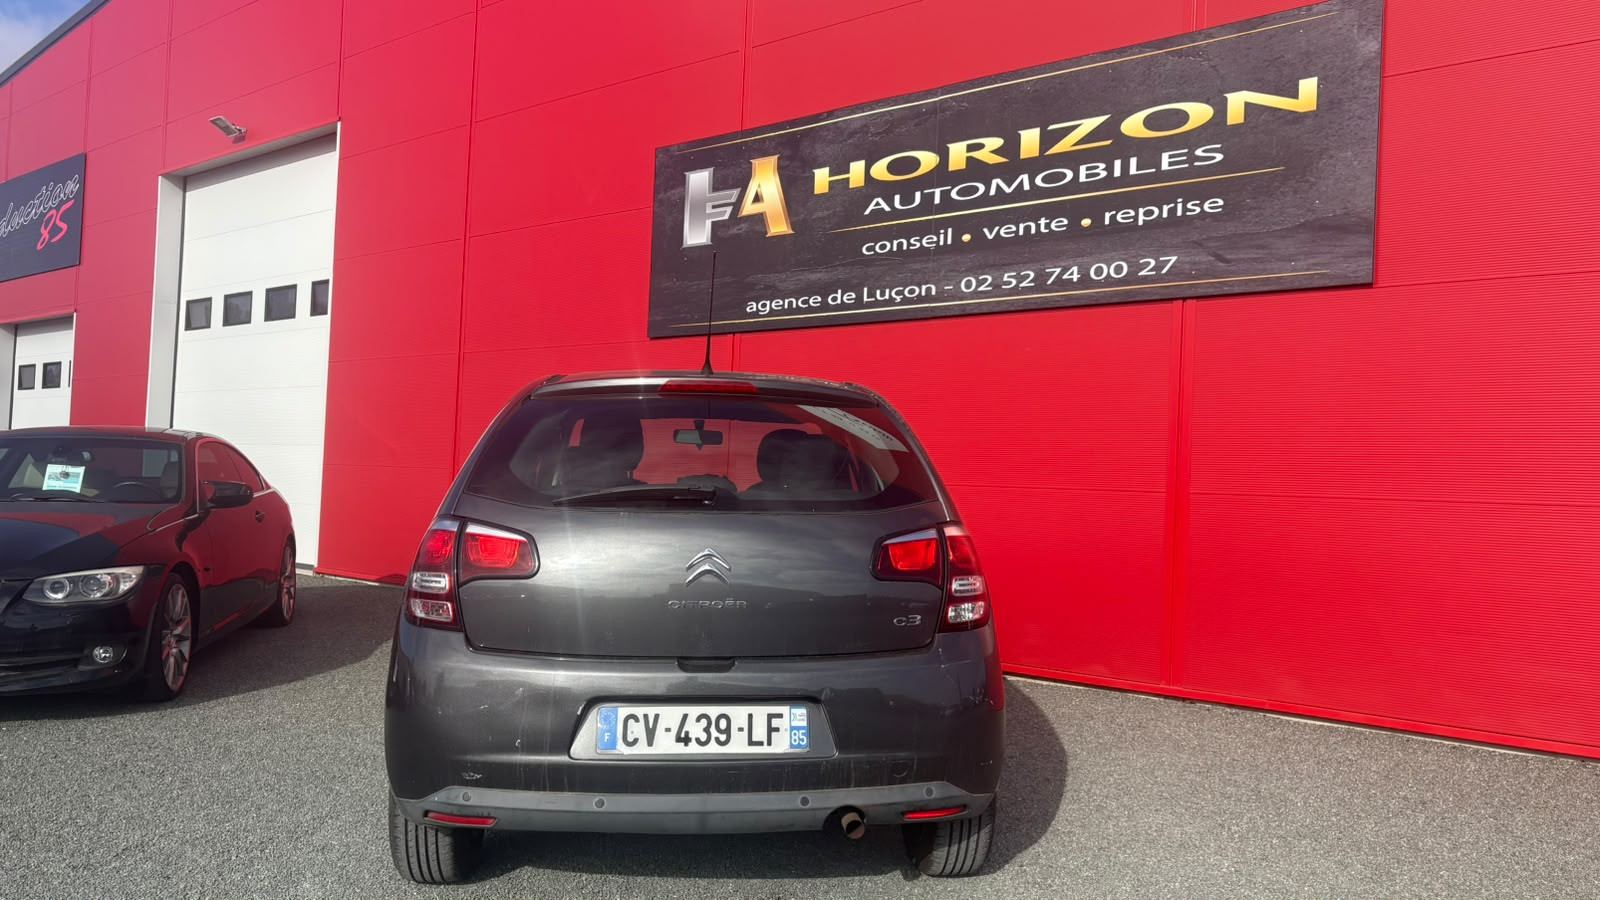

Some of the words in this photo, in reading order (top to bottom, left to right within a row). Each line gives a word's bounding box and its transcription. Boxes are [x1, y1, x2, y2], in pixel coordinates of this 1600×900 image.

[812, 76, 1319, 195] HORIZON
[863, 143, 1225, 216] AUTOMOBILES
[36, 199, 75, 251] 85
[861, 227, 953, 256] conseil
[982, 216, 1069, 240] vente
[1103, 196, 1225, 226] reprise
[745, 295, 822, 316] agence
[827, 288, 857, 305] de
[863, 283, 937, 304] Luçon
[960, 275, 993, 294] 02
[1001, 270, 1036, 290] 52
[1046, 265, 1081, 286] 74
[1089, 260, 1128, 282] 00
[1138, 255, 1179, 275] 27
[604, 732, 611, 743] F
[622, 713, 784, 748] CV-439-LF
[791, 729, 807, 746] 85
